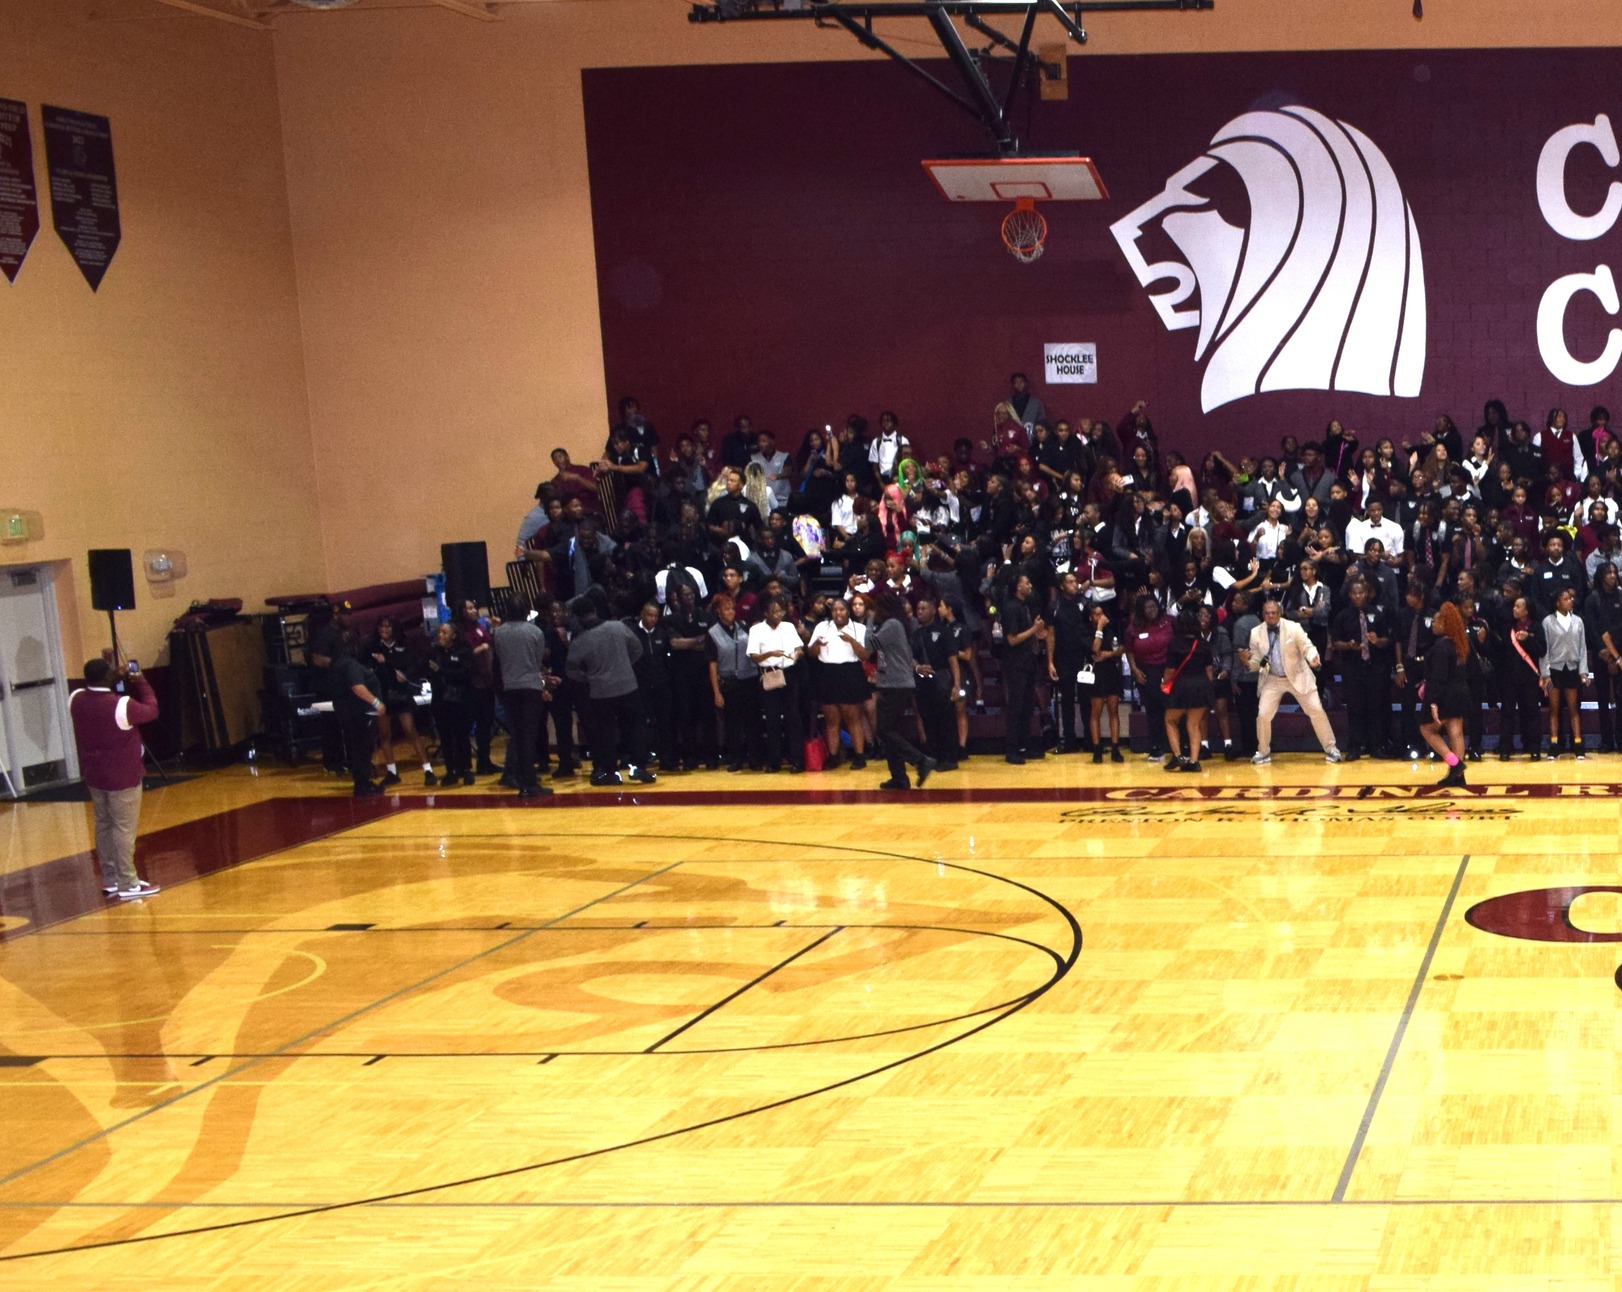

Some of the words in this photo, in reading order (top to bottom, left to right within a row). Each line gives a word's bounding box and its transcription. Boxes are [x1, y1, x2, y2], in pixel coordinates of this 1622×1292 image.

[1046, 354, 1093, 364] SHOCKLEE
[1056, 365, 1085, 375] HOUSE
[1105, 786, 1530, 799] CARDINAL
